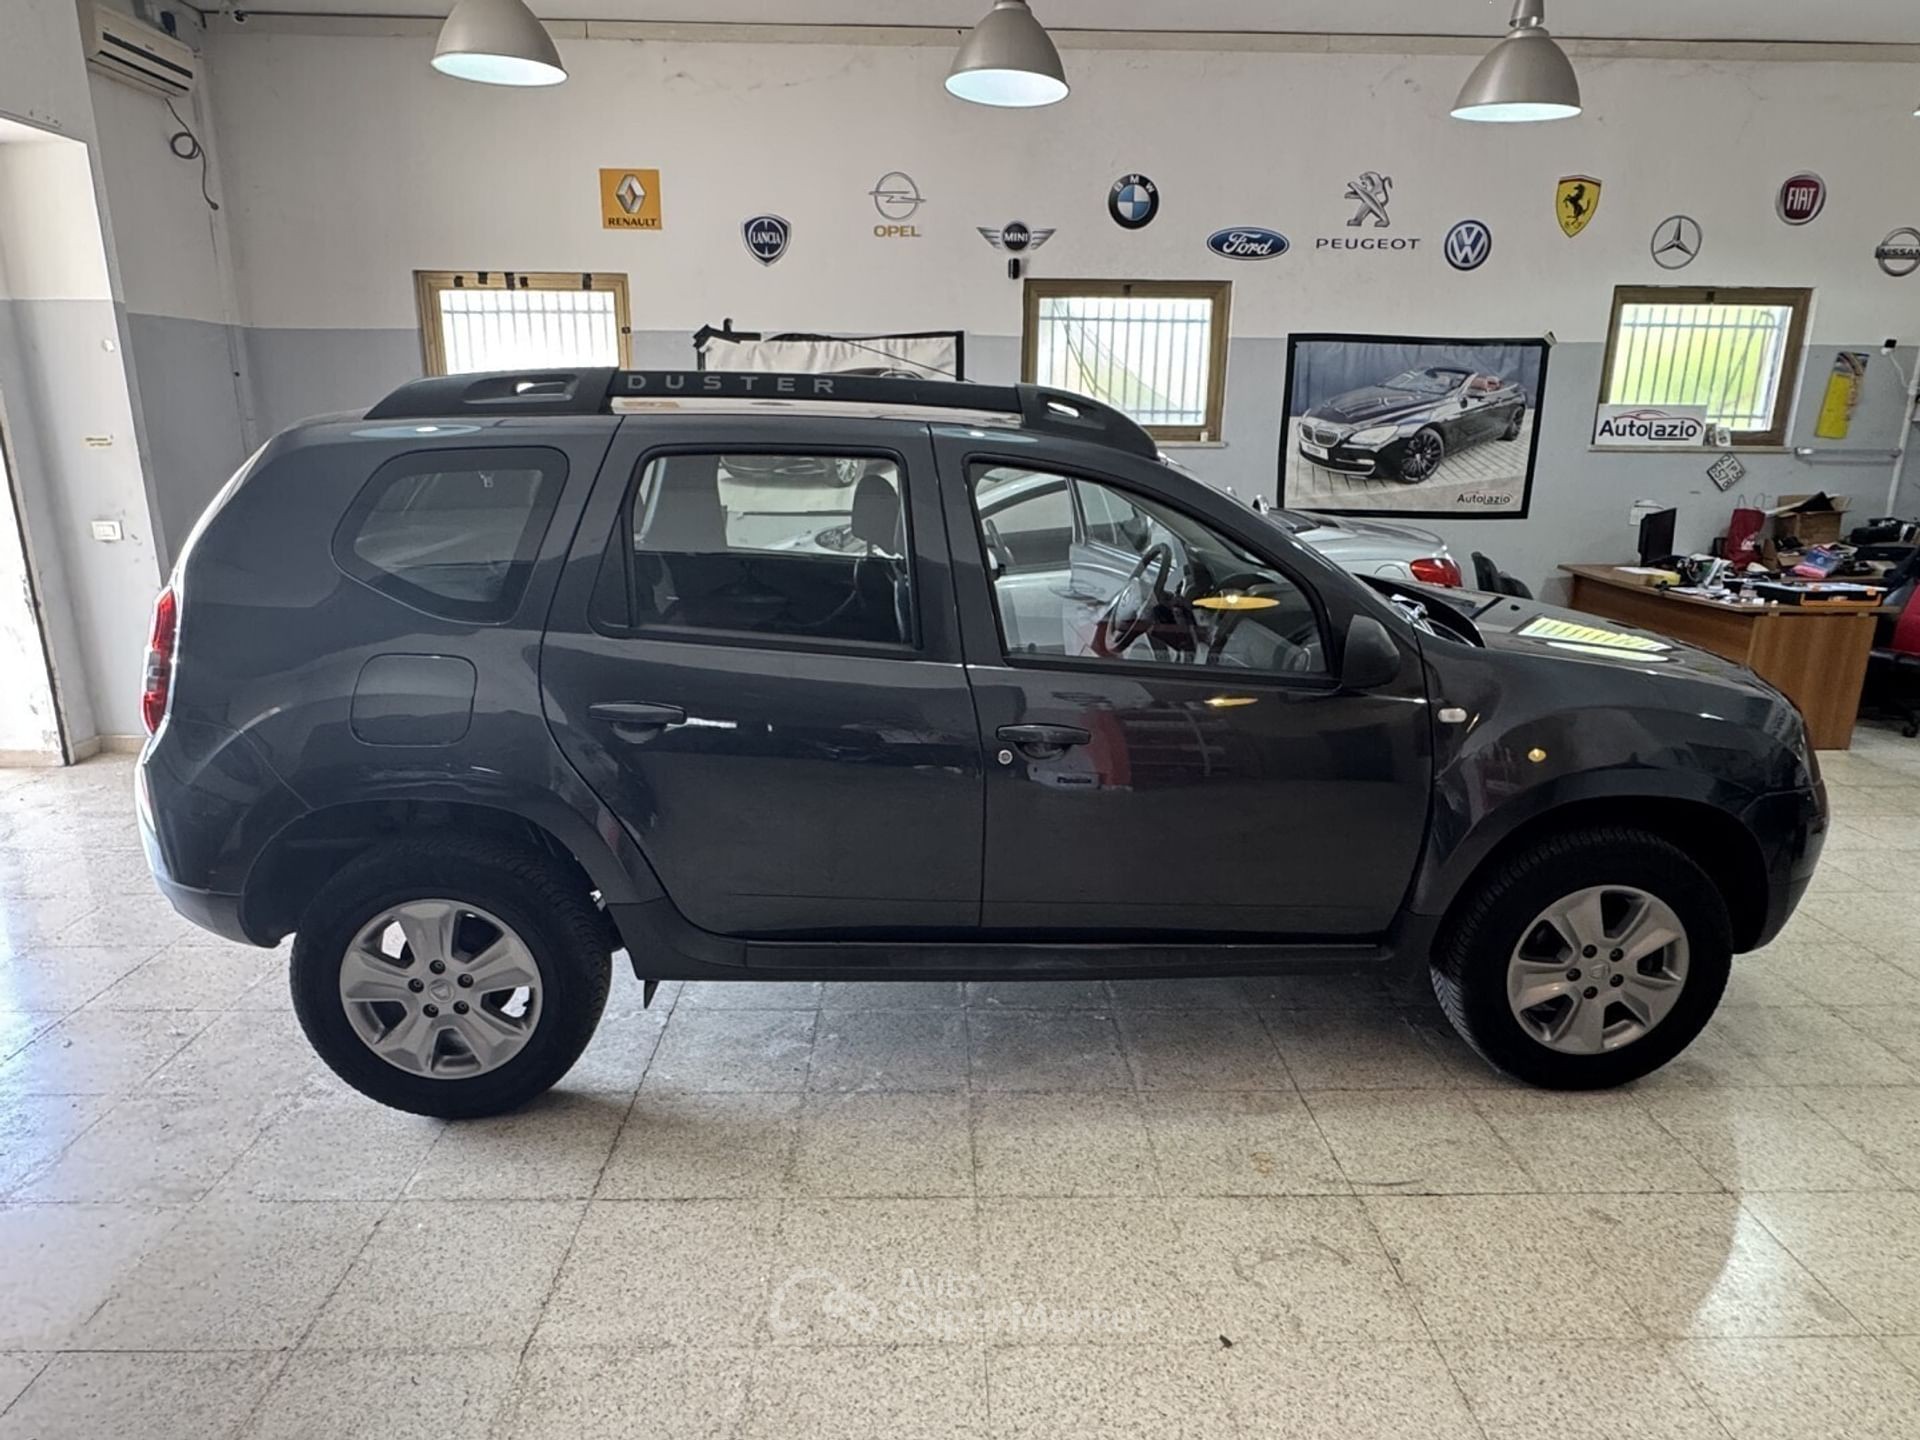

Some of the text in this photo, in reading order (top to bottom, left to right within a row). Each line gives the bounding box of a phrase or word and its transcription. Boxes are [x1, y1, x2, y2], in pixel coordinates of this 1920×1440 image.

[1114, 175, 1156, 193] BMW
[1786, 186, 1817, 211] FIAT
[608, 217, 658, 227] RENAULT
[752, 231, 781, 244] LANCIA
[873, 225, 922, 238] OPEL
[1003, 233, 1029, 242] MINI
[1222, 232, 1274, 255] Ford
[1316, 238, 1421, 250] PEUGEOT
[627, 374, 835, 394] DUSTER
[1599, 419, 1698, 441] AutoLazio
[1456, 492, 1512, 506] AutoLazio
